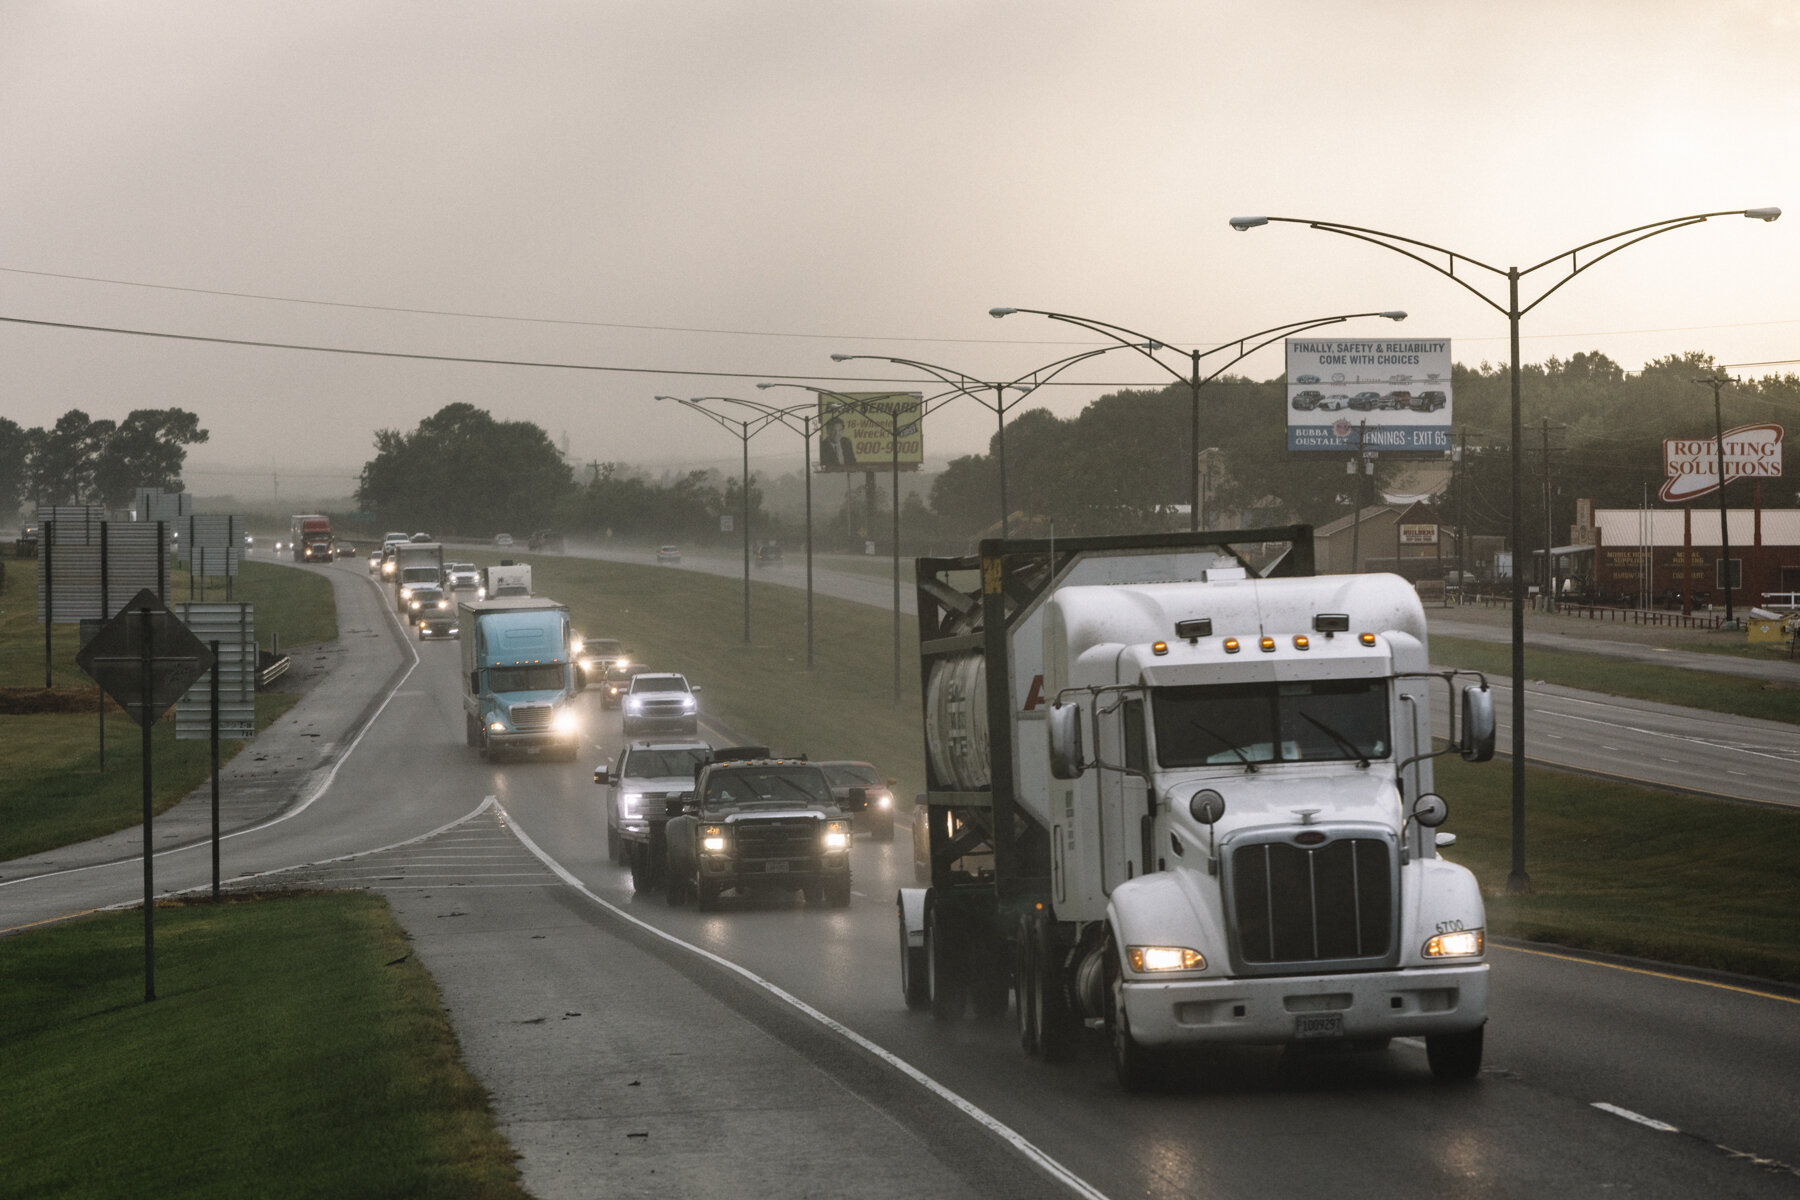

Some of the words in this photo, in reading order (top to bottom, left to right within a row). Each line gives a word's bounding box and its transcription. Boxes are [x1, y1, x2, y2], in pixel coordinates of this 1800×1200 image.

[1294, 344, 1334, 353] FINALLY,
[1337, 344, 1373, 353] SAFETY
[1376, 344, 1385, 353] &
[1387, 344, 1445, 353] RELIABILITY
[1319, 355, 1347, 364] COME
[1350, 355, 1375, 364] WITH
[1377, 355, 1420, 364] CHOICES
[1413, 431, 1433, 445] EXIT
[1434, 431, 1447, 445] 65
[1674, 442, 1775, 456] ROTATING
[1669, 461, 1780, 475] SOLUTIONS
[1435, 919, 1464, 933] 6700
